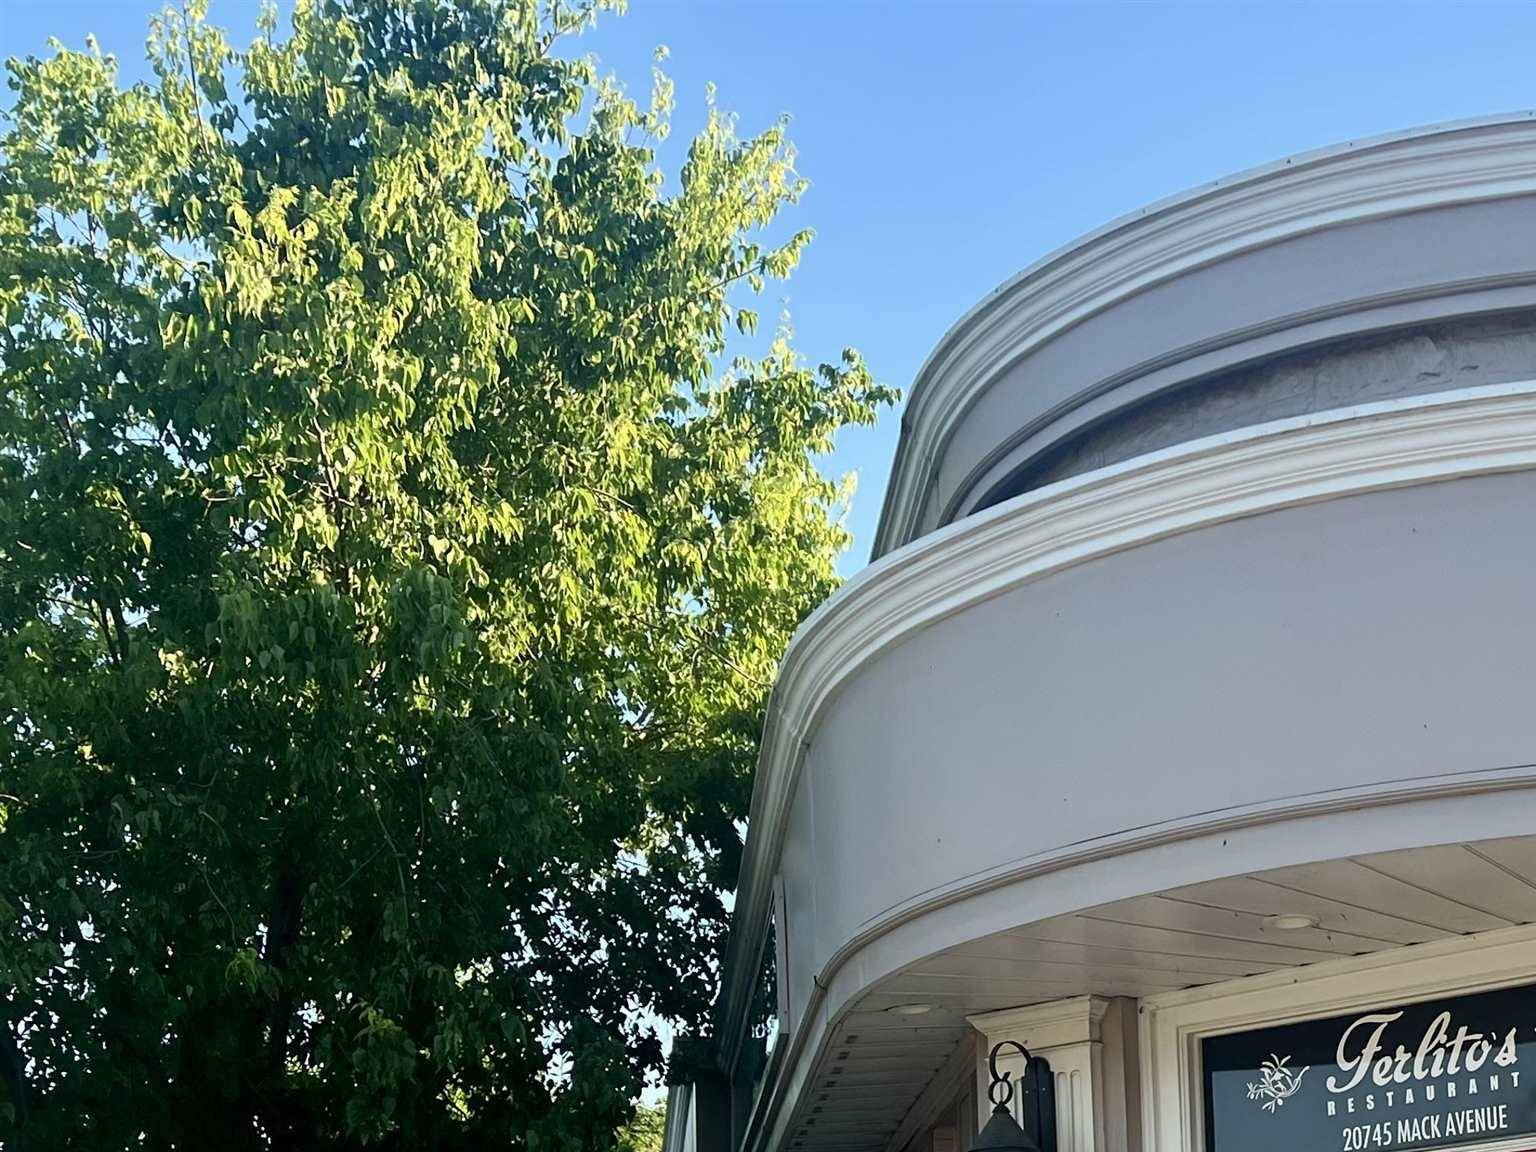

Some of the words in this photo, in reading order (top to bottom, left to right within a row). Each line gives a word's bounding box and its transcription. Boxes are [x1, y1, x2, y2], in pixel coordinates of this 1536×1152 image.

[1326, 1010, 1519, 1094] Ferlito's
[1327, 1071, 1520, 1116] RESTAURANT
[1341, 1123, 1393, 1152] 20745
[1396, 1114, 1442, 1145] MACK
[1445, 1104, 1508, 1136] AVENUE
